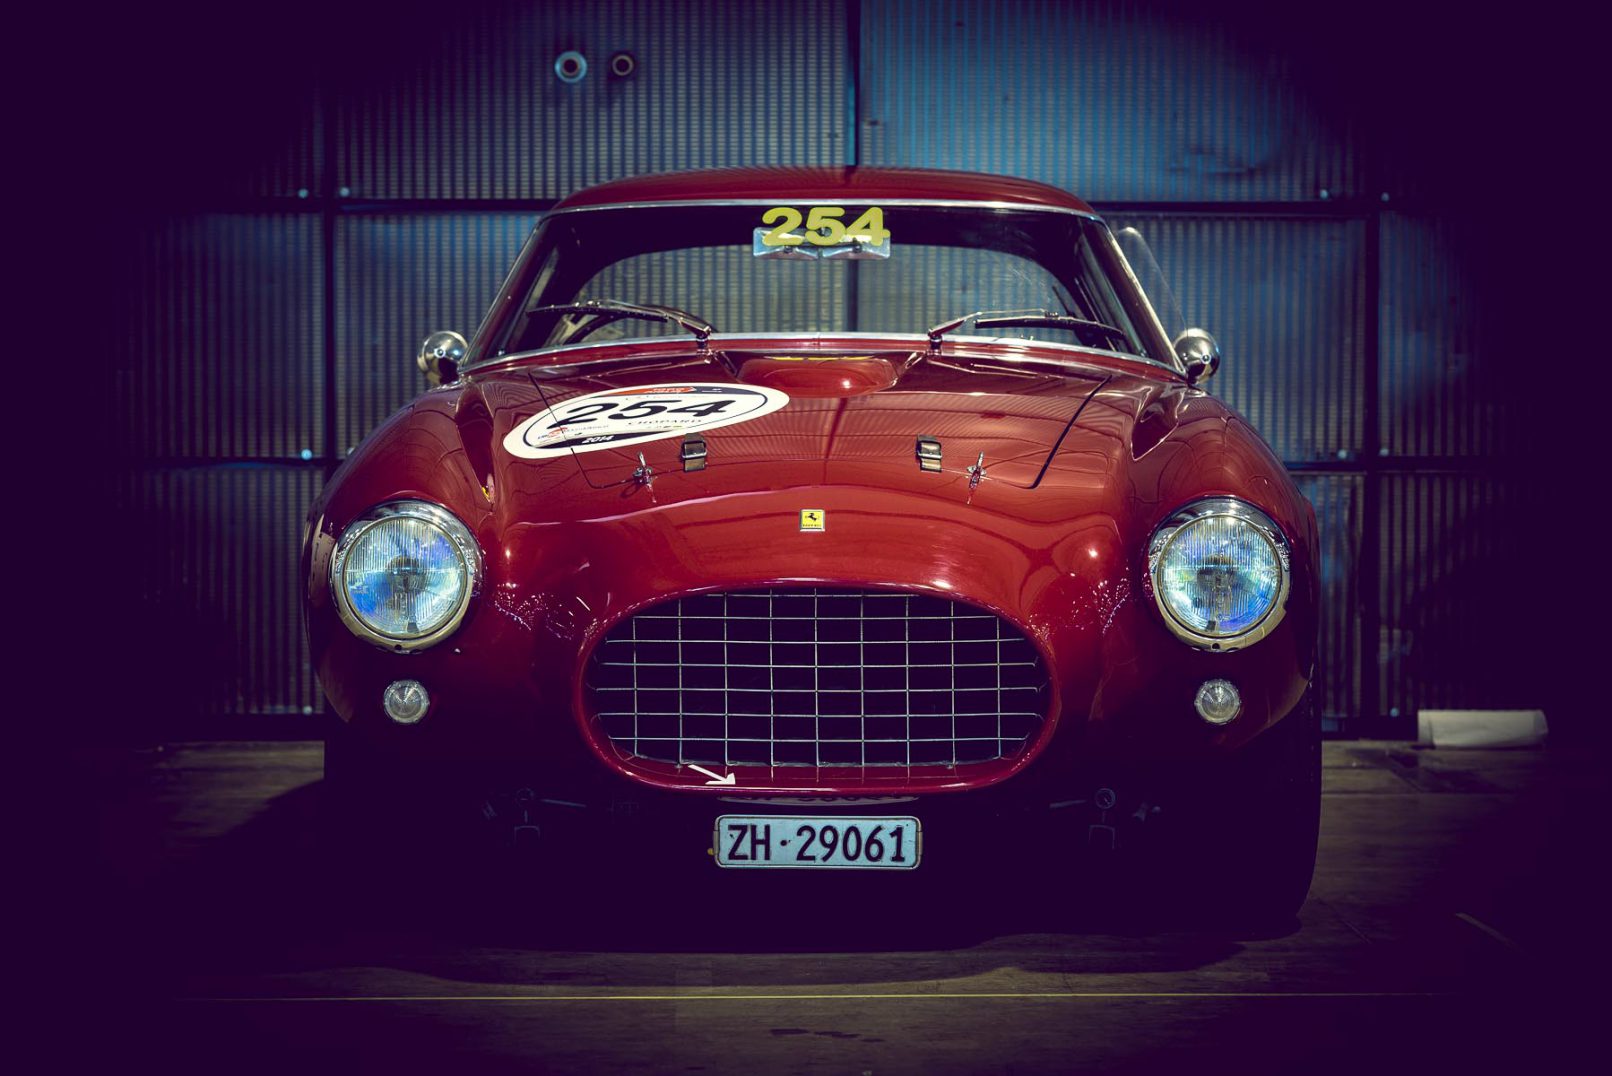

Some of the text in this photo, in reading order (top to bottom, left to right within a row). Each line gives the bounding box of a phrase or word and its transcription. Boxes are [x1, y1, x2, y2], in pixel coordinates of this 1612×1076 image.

[762, 206, 891, 247] 254
[546, 399, 737, 429] 254
[581, 434, 615, 445] 2014
[728, 824, 772, 861] ZH
[796, 824, 906, 862] 29061
